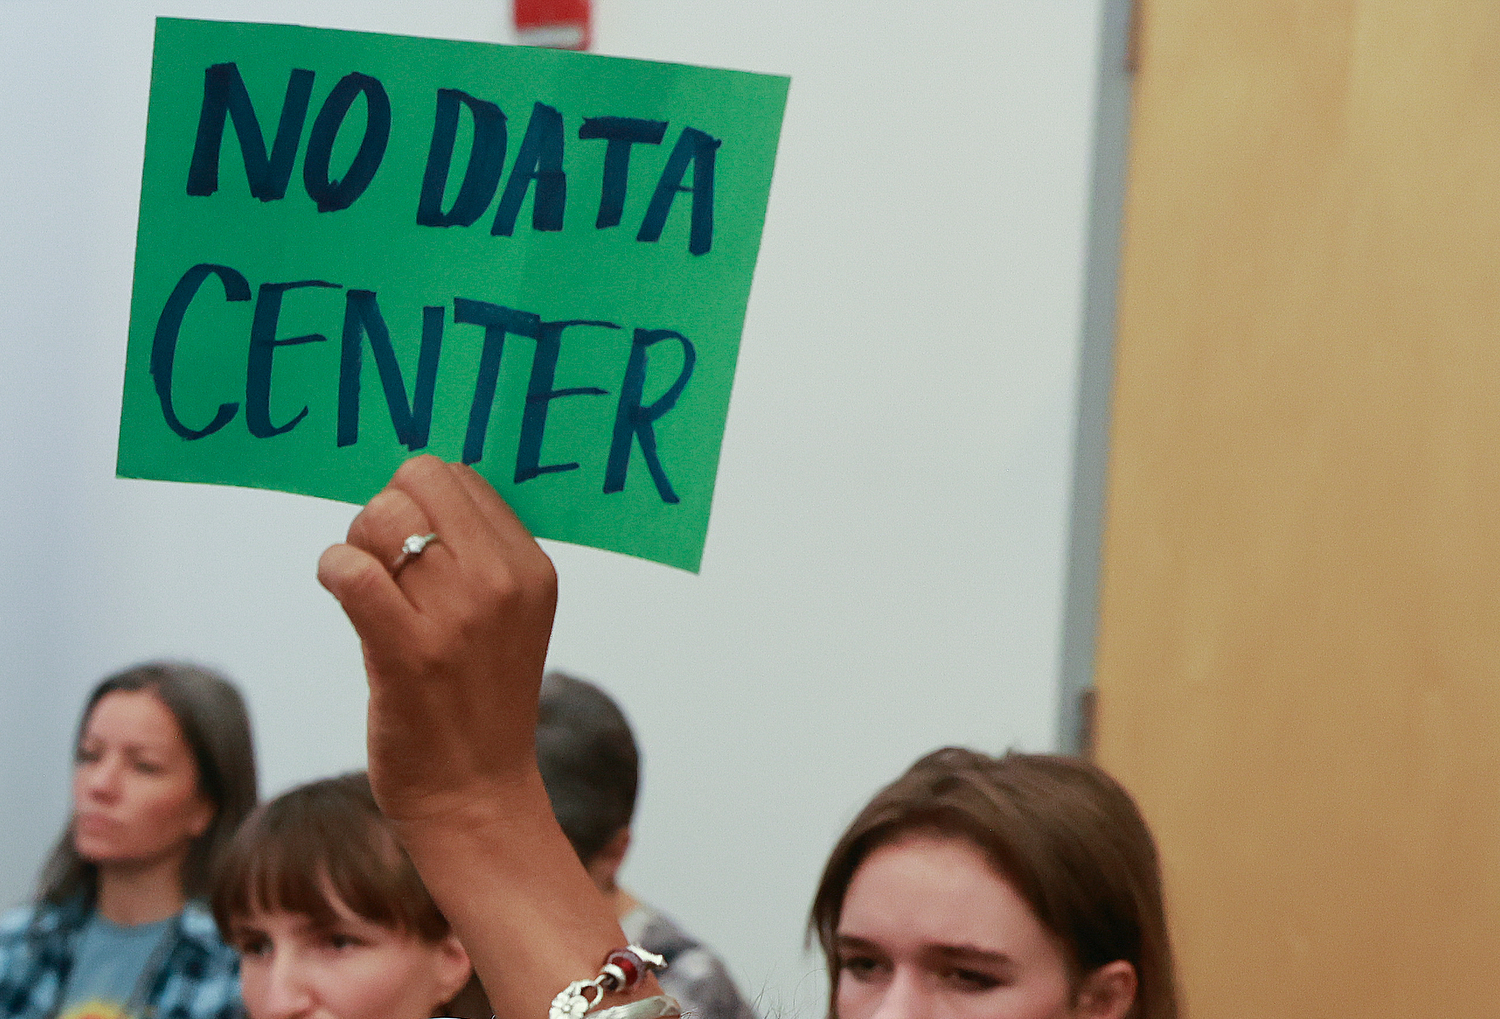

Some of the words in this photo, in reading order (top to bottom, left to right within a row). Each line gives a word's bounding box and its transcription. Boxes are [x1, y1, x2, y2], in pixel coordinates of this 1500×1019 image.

[186, 61, 392, 214] NO
[416, 88, 722, 257] DATA
[149, 262, 697, 505] CENTER
